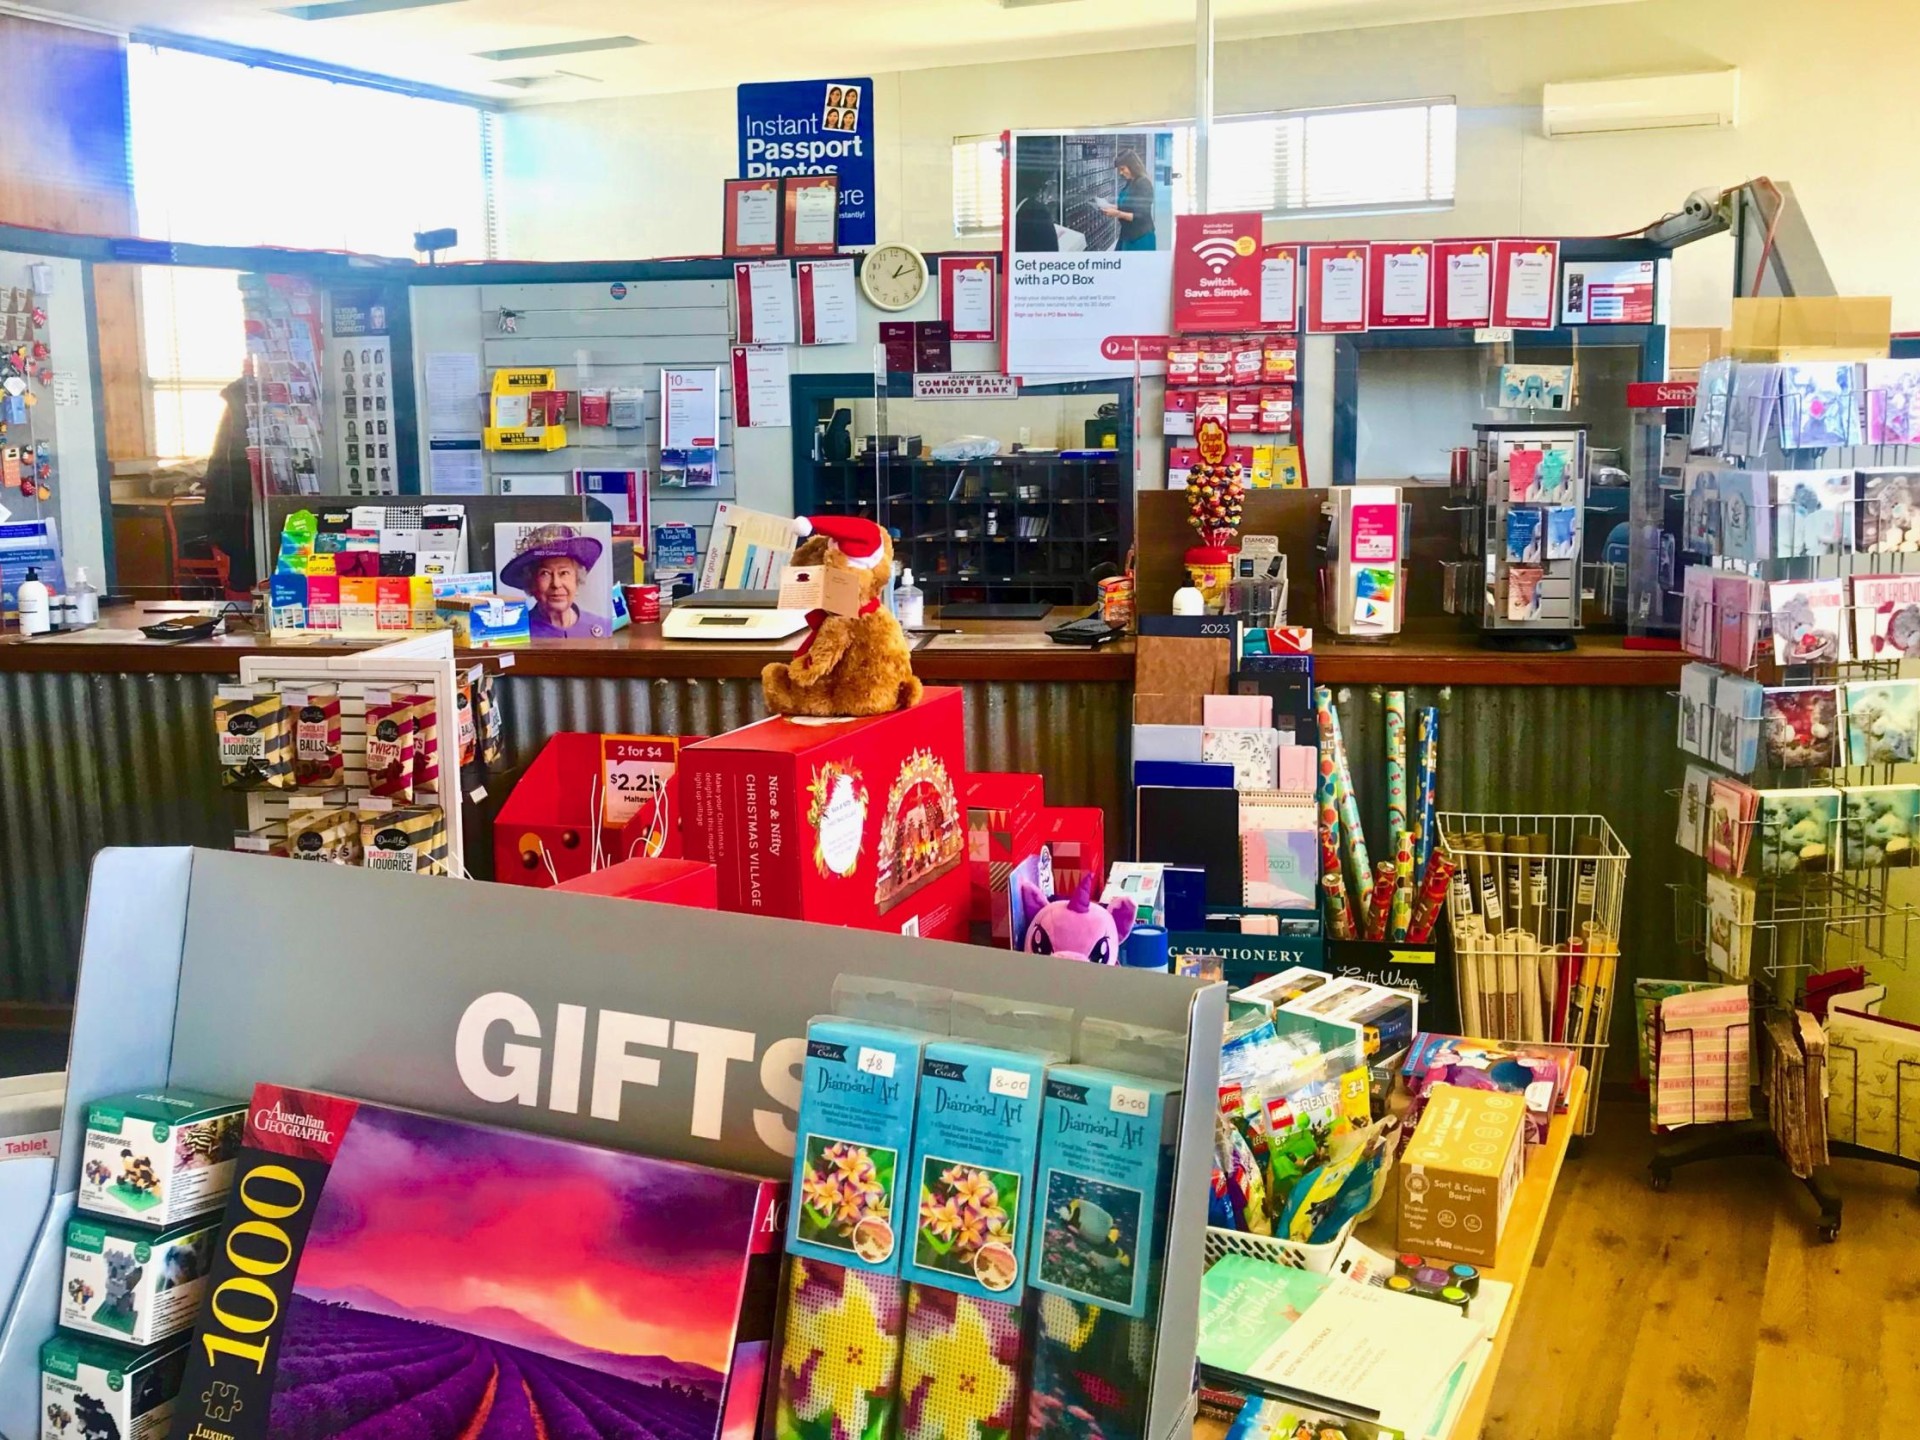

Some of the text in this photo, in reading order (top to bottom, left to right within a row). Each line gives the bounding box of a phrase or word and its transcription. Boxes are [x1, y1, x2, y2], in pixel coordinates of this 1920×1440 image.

[746, 113, 819, 136] Instant
[747, 136, 863, 163] Passport
[839, 189, 864, 206] ere
[1015, 258, 1121, 272] Get peace of mind
[1015, 274, 1094, 285] with a PO Box
[1200, 277, 1237, 287] Switch.
[1184, 287, 1252, 298] Save. Simple.
[670, 374, 683, 386] 10
[918, 379, 1012, 387] COMMONWEALTH
[921, 386, 1008, 395] SAVINGS BANK
[1657, 386, 1696, 401] SanD
[1200, 624, 1230, 634] 2023
[223, 744, 261, 756] LIQUORICE
[300, 740, 325, 752] BALLS
[617, 745, 662, 757] 2 for $4
[610, 773, 661, 792] $2.25
[705, 772, 713, 799] delight
[624, 795, 651, 803] Maltes
[694, 772, 703, 827] light up village
[768, 775, 782, 856] Nice & Nifty
[716, 812, 724, 851] Christmas
[745, 774, 762, 907] CHRISTMAS VILLAGE
[395, 851, 414, 860] FRESH
[367, 859, 412, 872] LIQUORICE
[1269, 860, 1291, 869] 2023
[1185, 947, 1305, 962] STATIONERY
[1380, 969, 1423, 990] Wrap
[455, 991, 808, 1159] GIFTS
[817, 1066, 899, 1105] Diamond Art
[934, 1086, 1023, 1127] Diamond Art
[269, 1101, 325, 1129] Australian
[254, 1109, 335, 1145] GEOGRAPHIC
[1058, 1105, 1119, 1138] Diamond
[1120, 1121, 1145, 1150] Art
[5, 1139, 48, 1154] Tablet
[87, 1141, 106, 1150] FROG
[88, 1133, 132, 1148] CORROBOREE
[1274, 1135, 1286, 1145] 6+
[1434, 1179, 1452, 1188] Sort
[1463, 1184, 1486, 1195] Count
[1449, 1191, 1472, 1202] Board
[1434, 1237, 1453, 1250] fun
[69, 1251, 92, 1263] KOALA
[202, 1164, 306, 1375] 1000
[196, 1423, 235, 1440] Luxury
